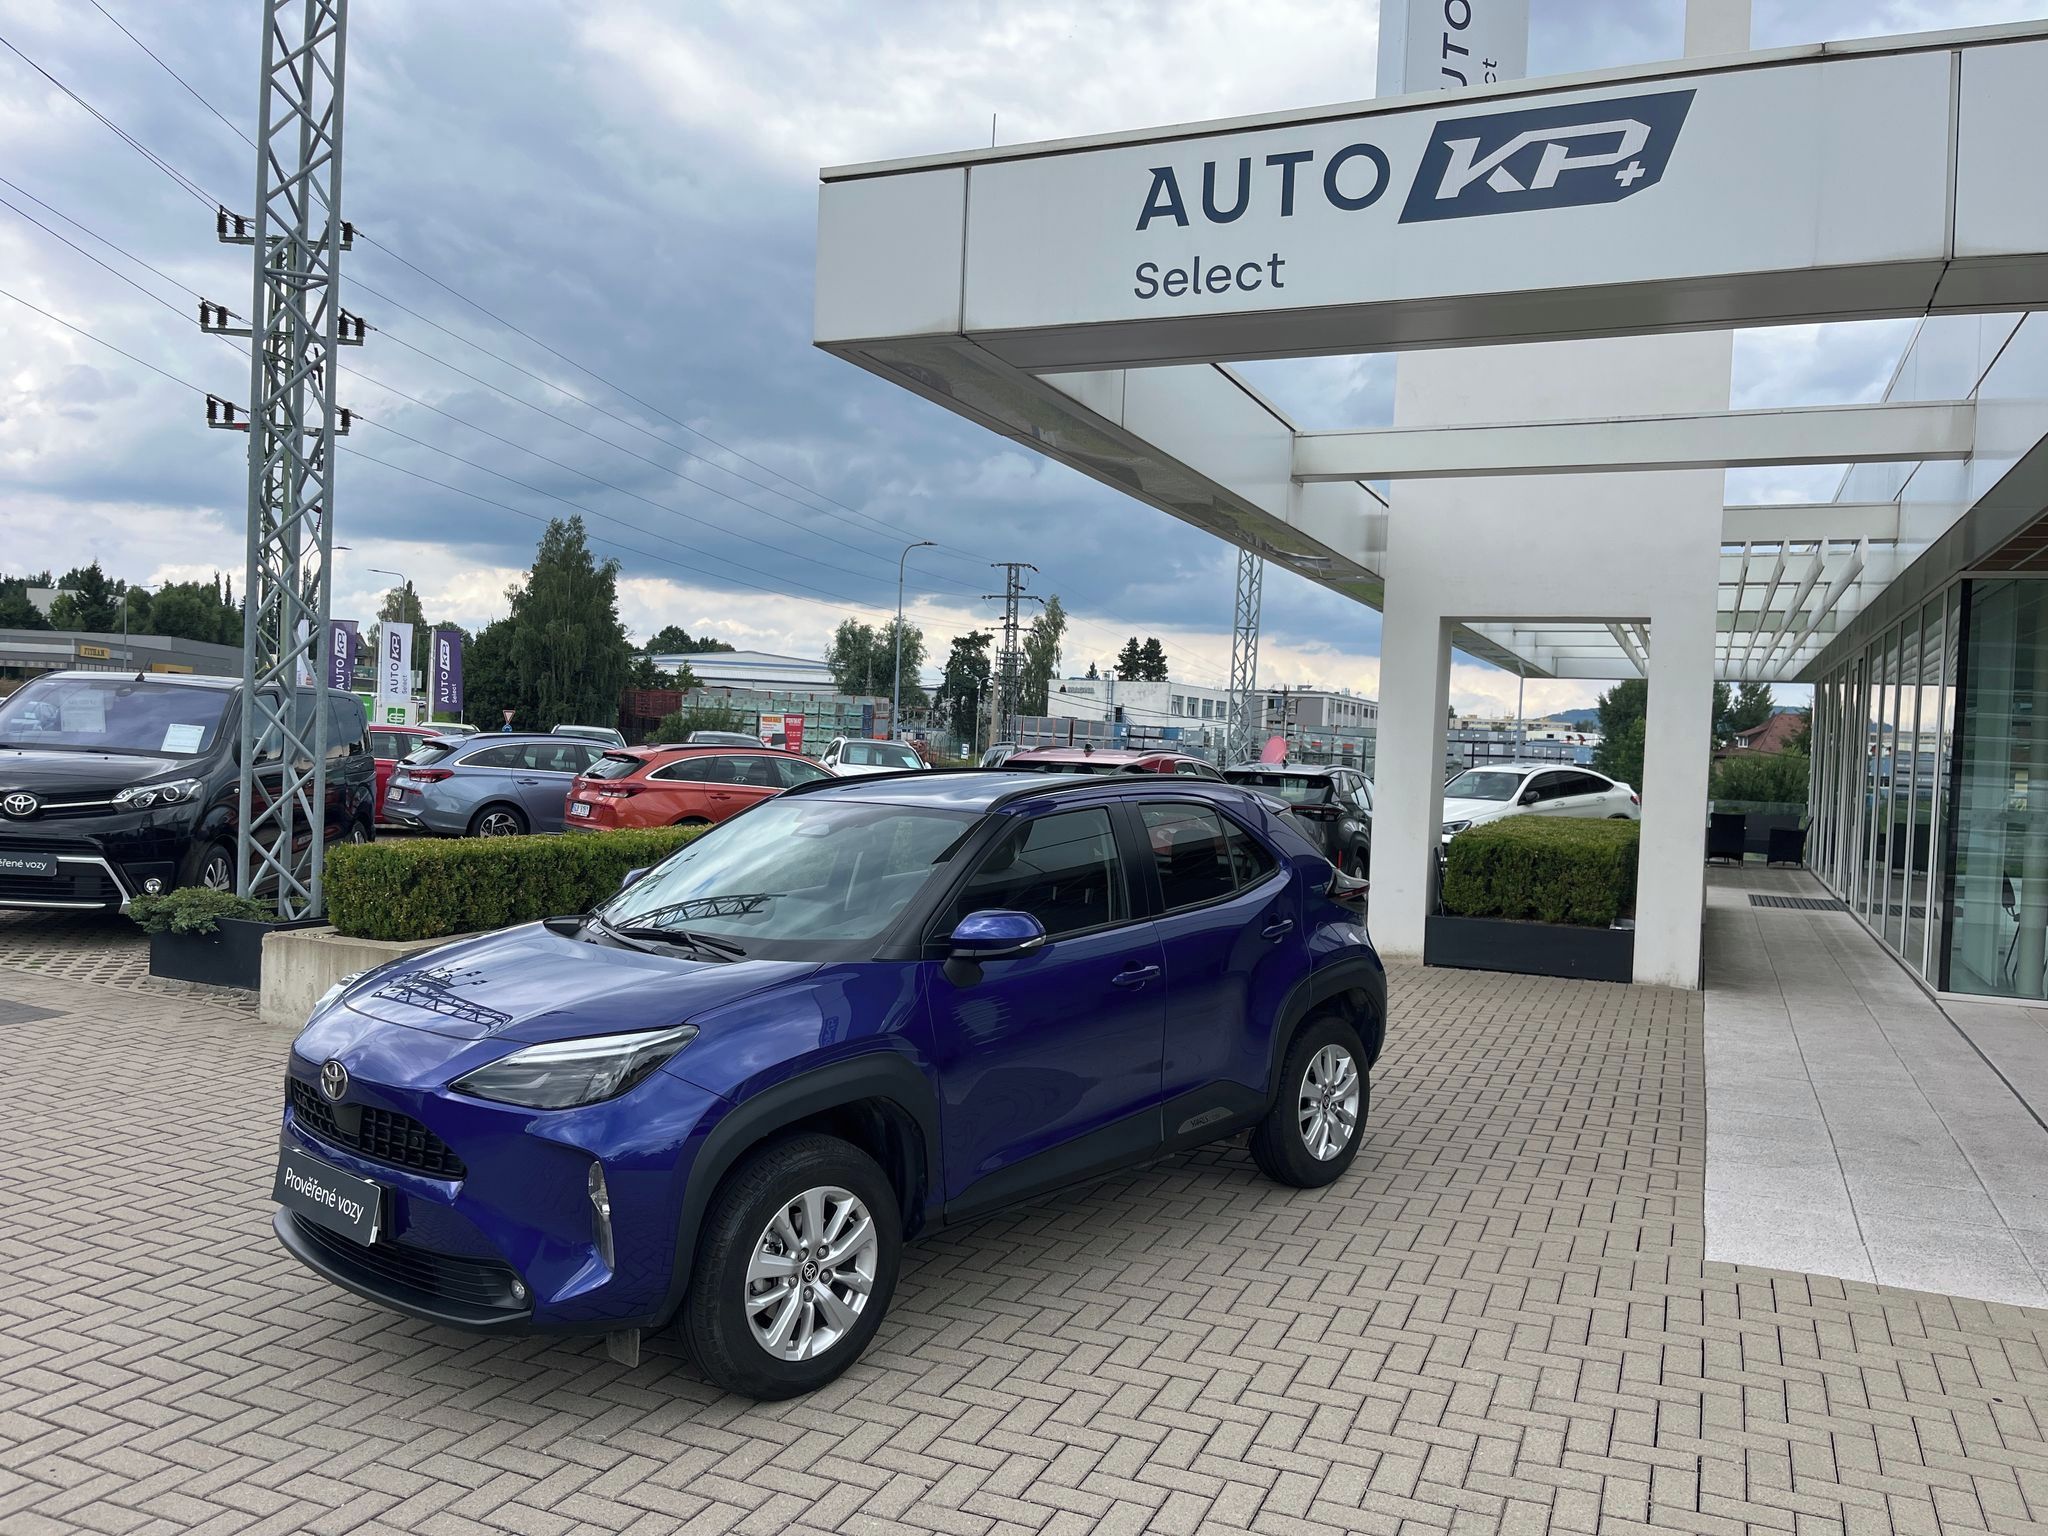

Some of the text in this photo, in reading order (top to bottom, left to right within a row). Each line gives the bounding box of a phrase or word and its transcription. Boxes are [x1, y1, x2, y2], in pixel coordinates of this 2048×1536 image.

[1441, 0, 1471, 87] UTO
[1135, 143, 1390, 231] AUTO
[1133, 252, 1286, 299] Select
[336, 659, 345, 690] AUTO
[390, 662, 399, 694] AUTO
[441, 671, 449, 703] AUTO
[25, 861, 47, 871] vozy
[284, 1167, 365, 1225] Prověřené vozy
